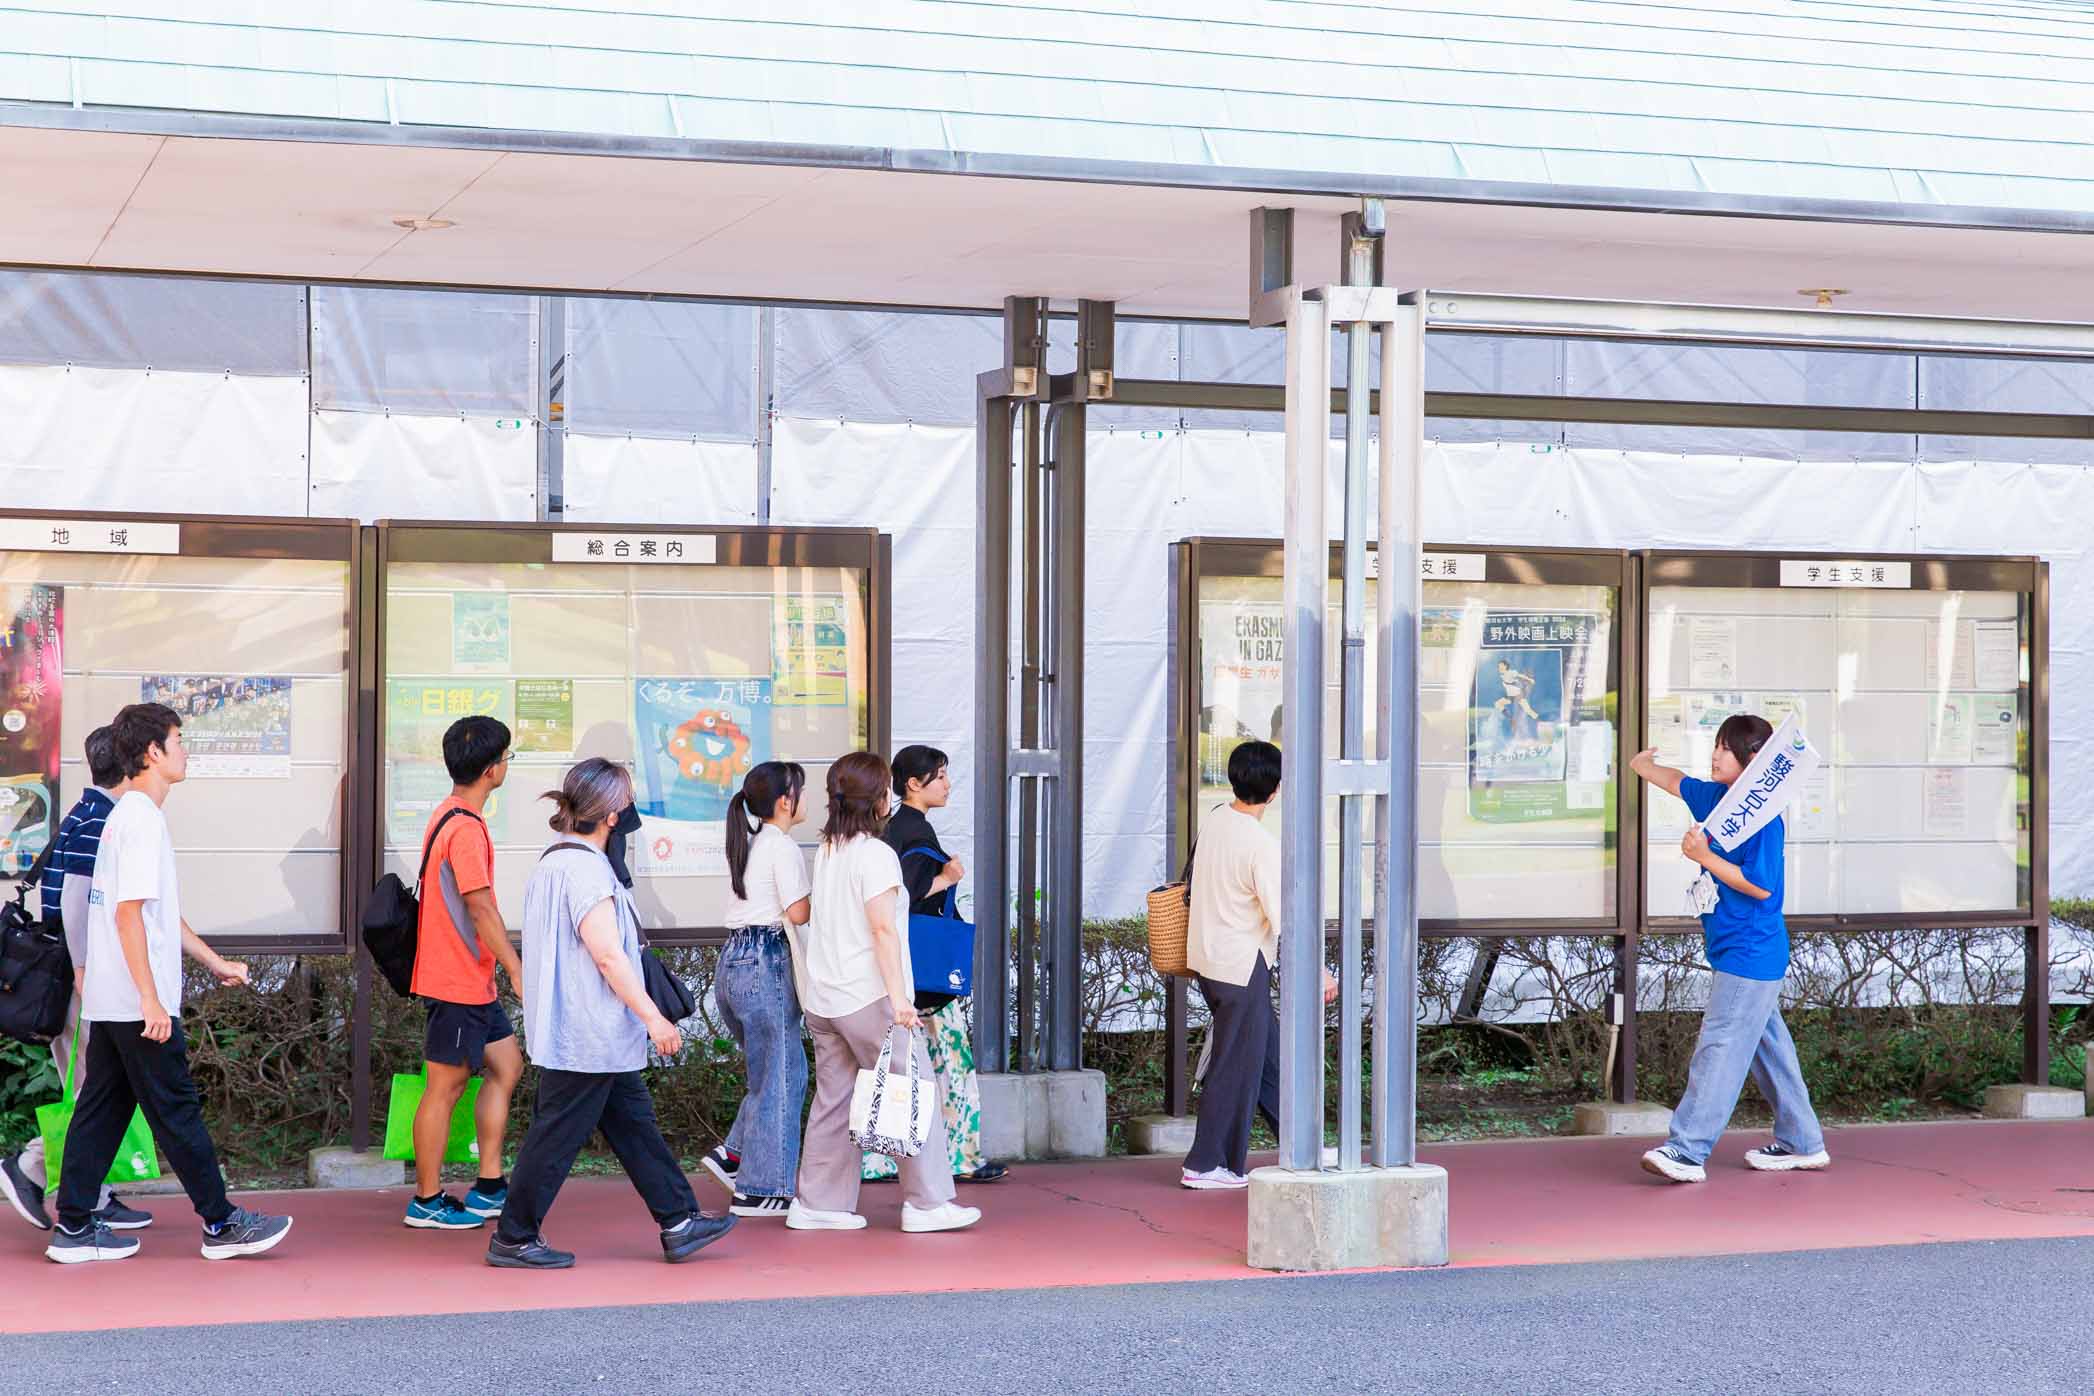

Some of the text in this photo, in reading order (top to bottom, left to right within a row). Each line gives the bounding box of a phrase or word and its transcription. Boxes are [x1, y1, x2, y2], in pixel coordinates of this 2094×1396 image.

[51, 527, 128, 546] 地域
[587, 538, 684, 558] 総合案内
[1807, 565, 1885, 583] 学生支援
[1490, 625, 1588, 641] 野外映画上映会
[639, 680, 772, 704] くるぞ、万博。
[1720, 752, 1795, 838] 駿河台大学
